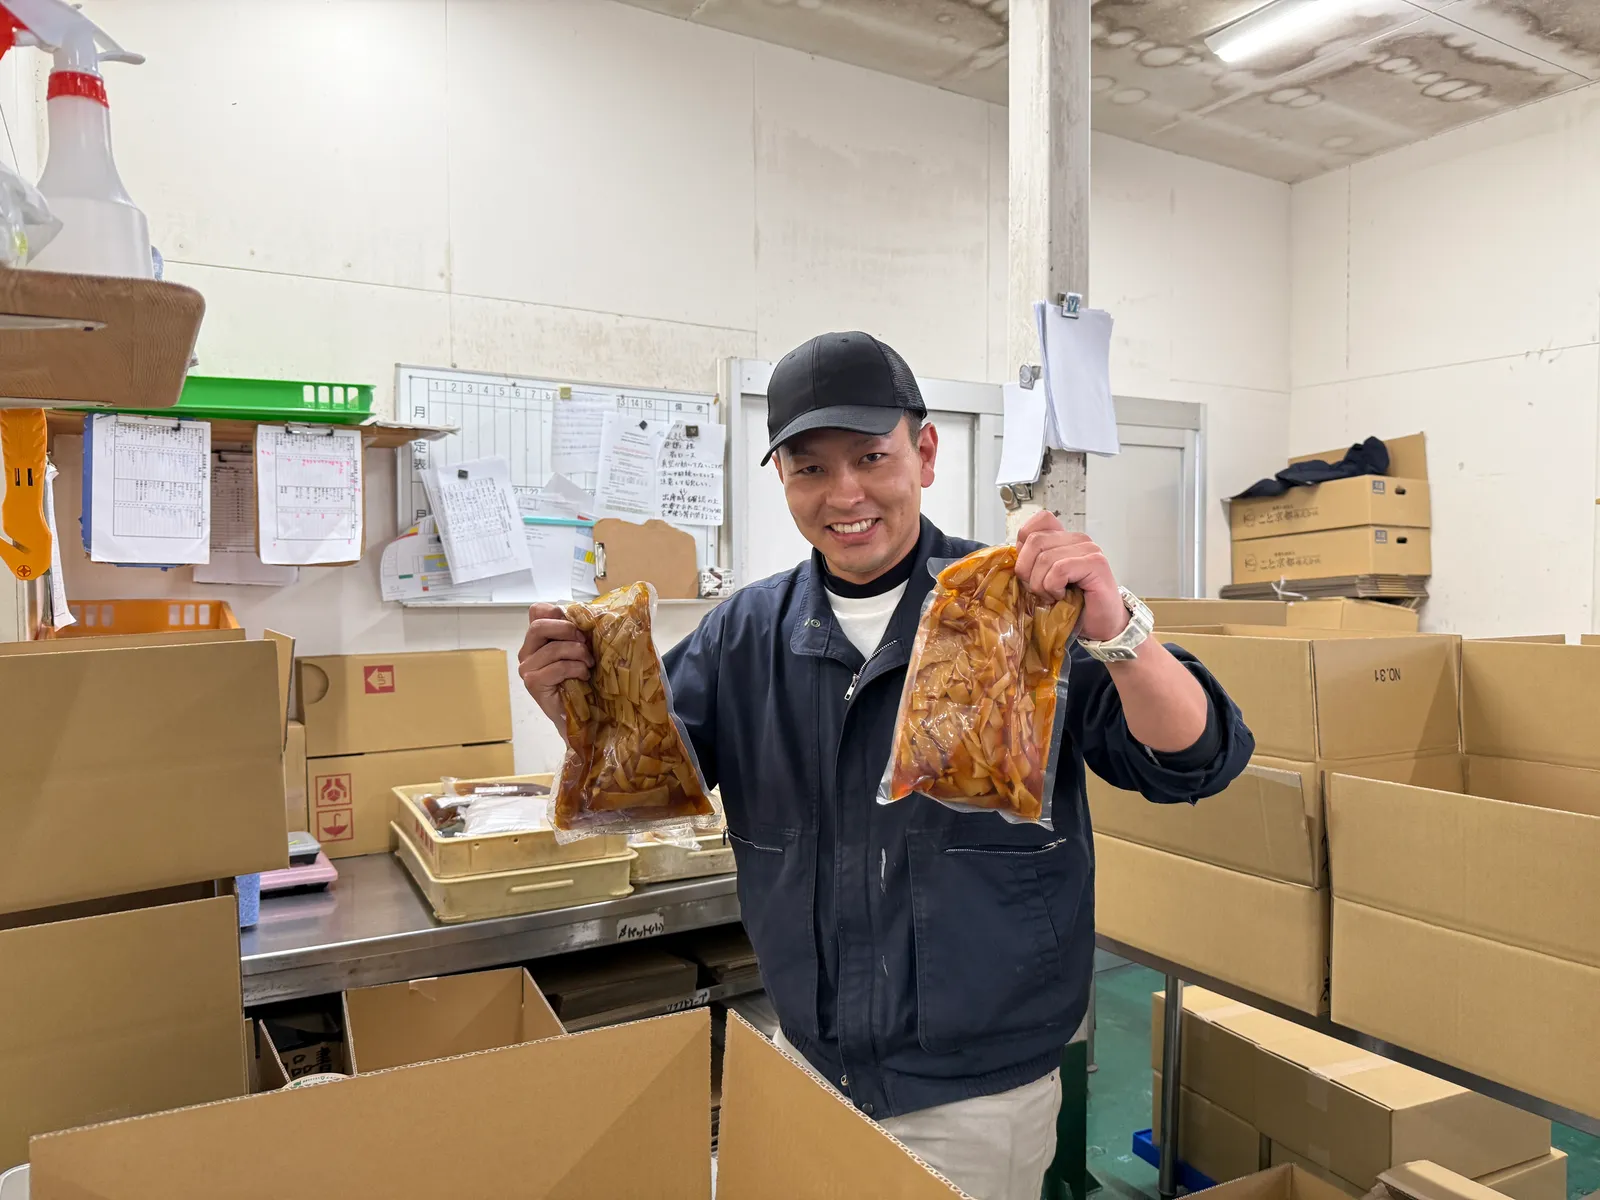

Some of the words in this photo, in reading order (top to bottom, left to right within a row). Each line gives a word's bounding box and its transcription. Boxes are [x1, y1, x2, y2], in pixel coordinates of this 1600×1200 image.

[451, 383, 457, 392] 2
[467, 384, 473, 393] 3
[483, 386, 489, 394] 4
[499, 387, 505, 396] 5
[515, 388, 521, 397] 6
[531, 390, 537, 399] 7
[617, 398, 626, 407] 13
[631, 399, 639, 407] 14
[645, 400, 653, 409] 15
[377, 673, 386, 686] UP
[1374, 668, 1401, 682] NO.31
